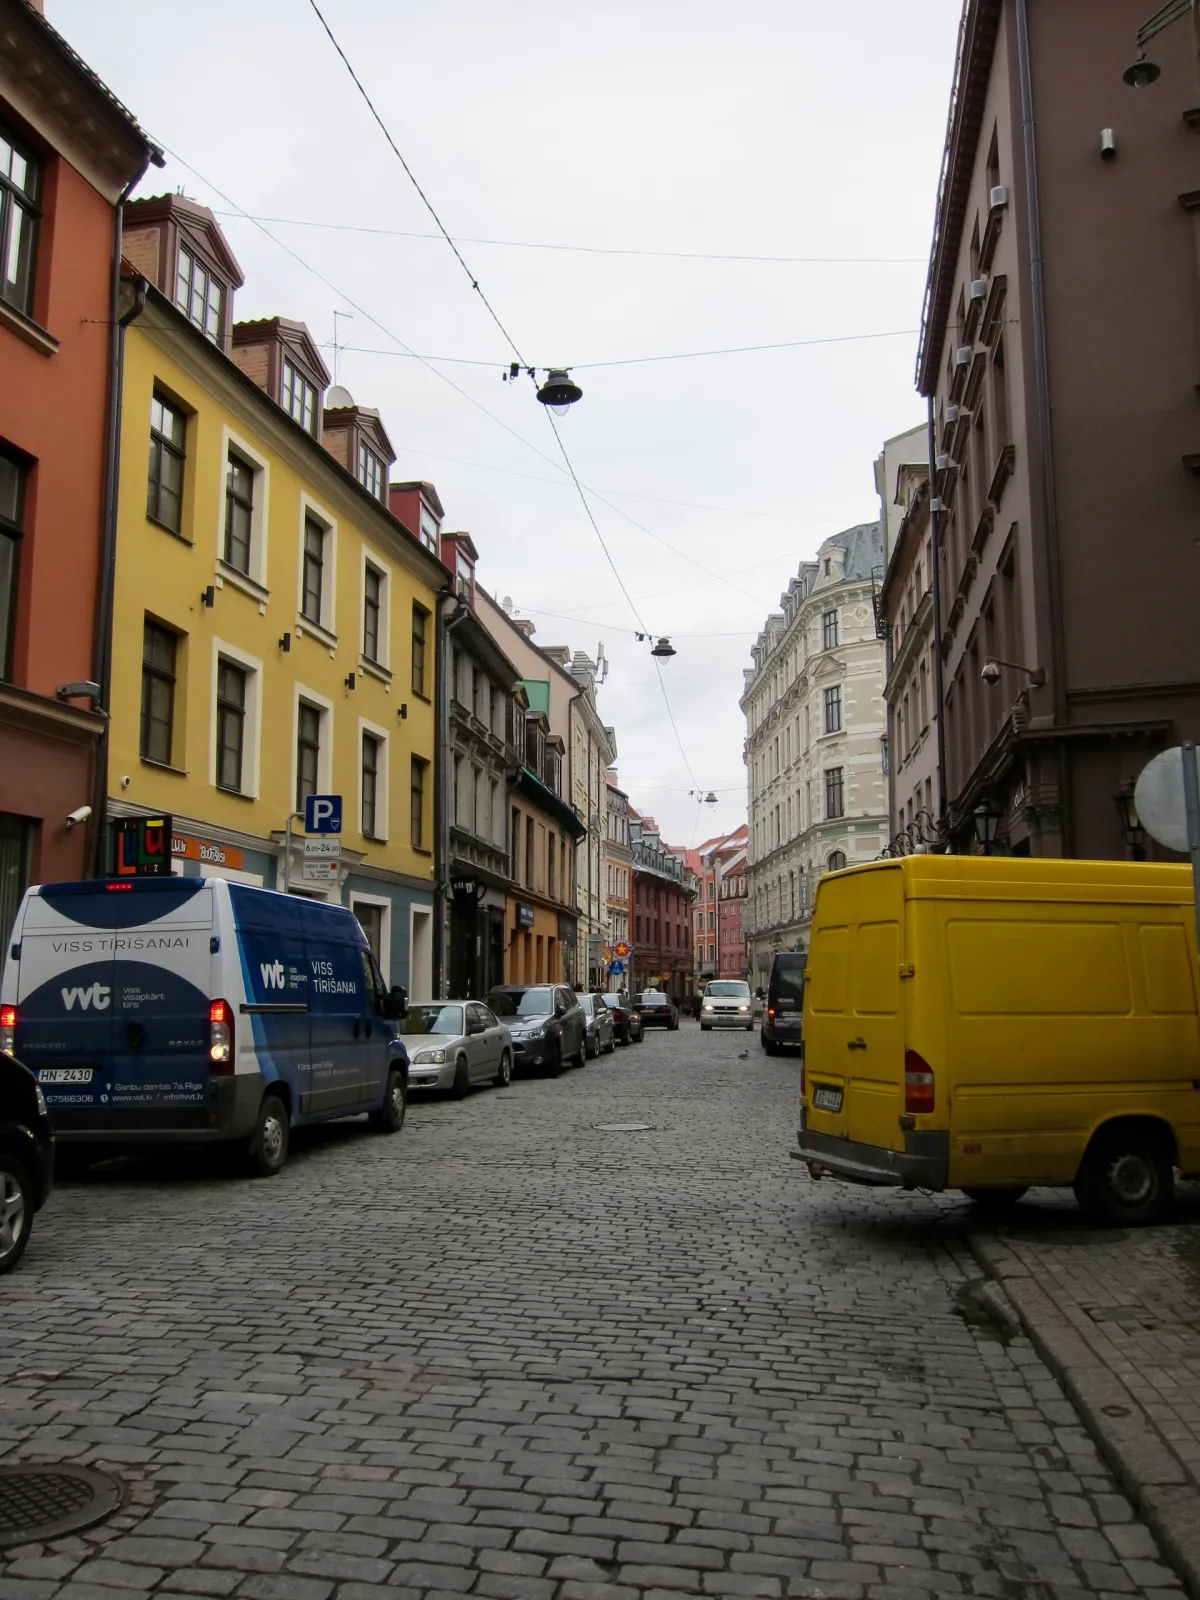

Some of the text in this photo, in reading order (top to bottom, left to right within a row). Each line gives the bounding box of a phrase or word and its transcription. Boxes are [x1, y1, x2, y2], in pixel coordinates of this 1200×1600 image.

[314, 800, 334, 829] P
[52, 937, 190, 953] VISS TĪRĪŠANAI
[311, 960, 334, 976] VISS
[312, 977, 357, 994] TĪRĪŠANAI
[40, 1069, 92, 1081] HN-2430
[46, 1094, 94, 1103] 67566306
